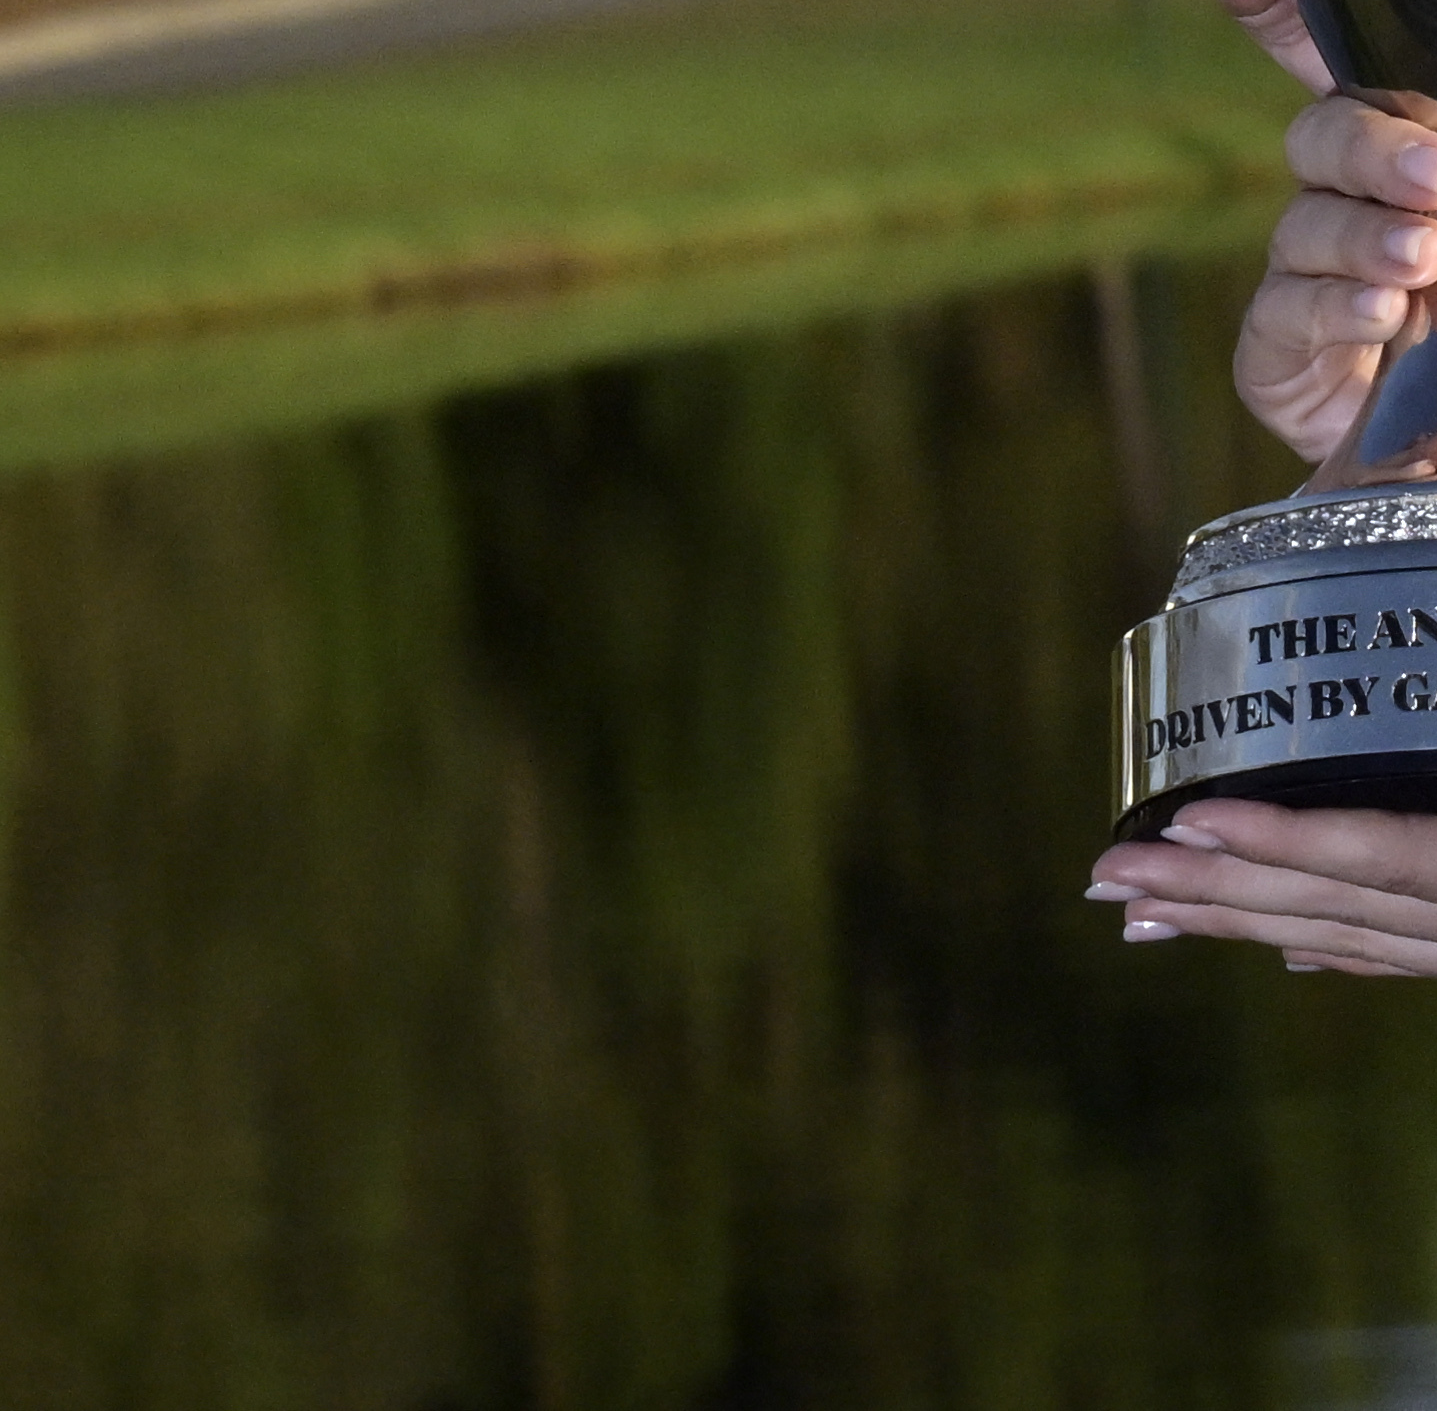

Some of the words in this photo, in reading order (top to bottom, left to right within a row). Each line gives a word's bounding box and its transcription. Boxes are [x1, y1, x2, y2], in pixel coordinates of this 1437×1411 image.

[1249, 613, 1357, 664] THE
[1145, 685, 1297, 760] DRIVEN
[1309, 675, 1380, 721] BY
